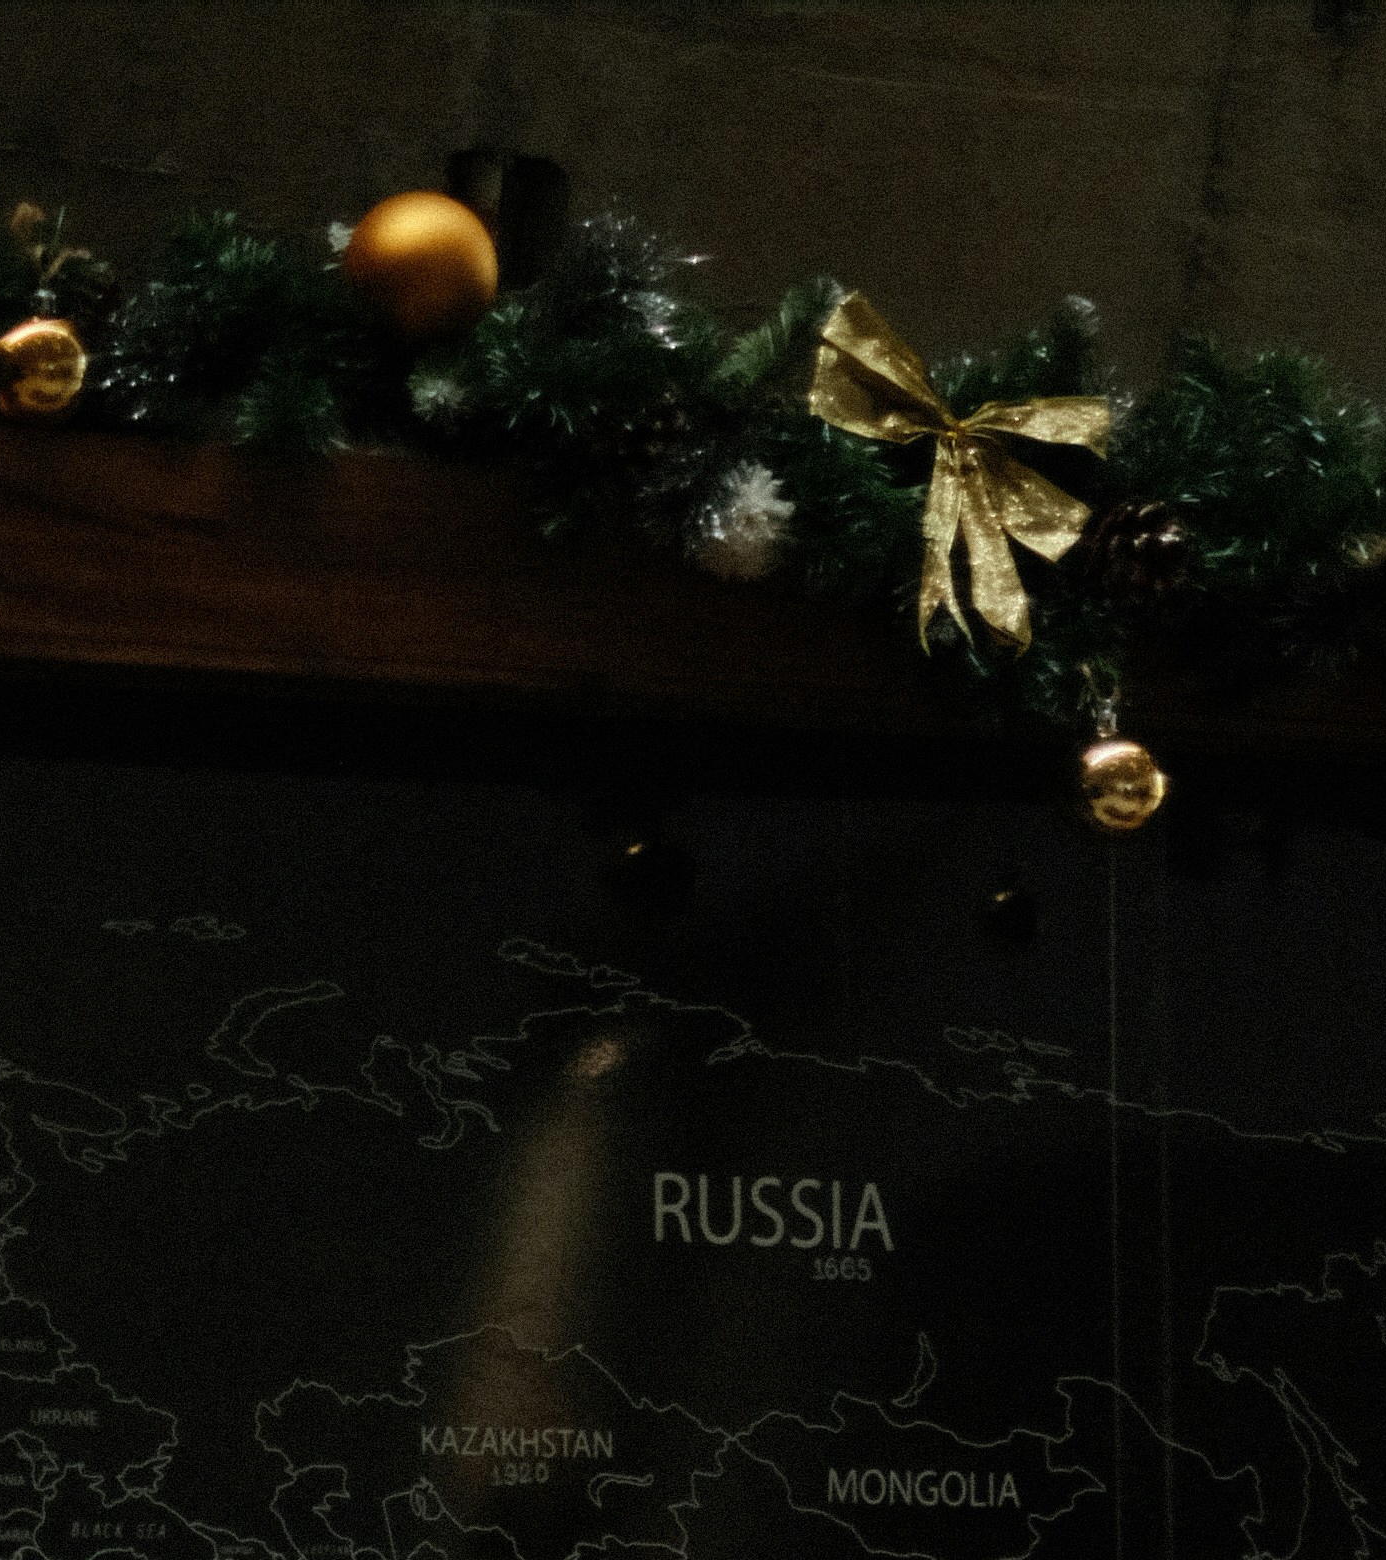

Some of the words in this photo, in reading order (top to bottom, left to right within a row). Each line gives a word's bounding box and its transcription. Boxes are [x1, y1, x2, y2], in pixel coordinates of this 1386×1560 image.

[652, 1171, 896, 1253] RUSSIA
[29, 1409, 99, 1427] UKRAINE
[420, 1426, 613, 1459] KAZAKHSTAN
[826, 1467, 1022, 1510] MONGOLIA
[72, 1522, 123, 1539] BLACK
[138, 1522, 167, 1539] SEA
